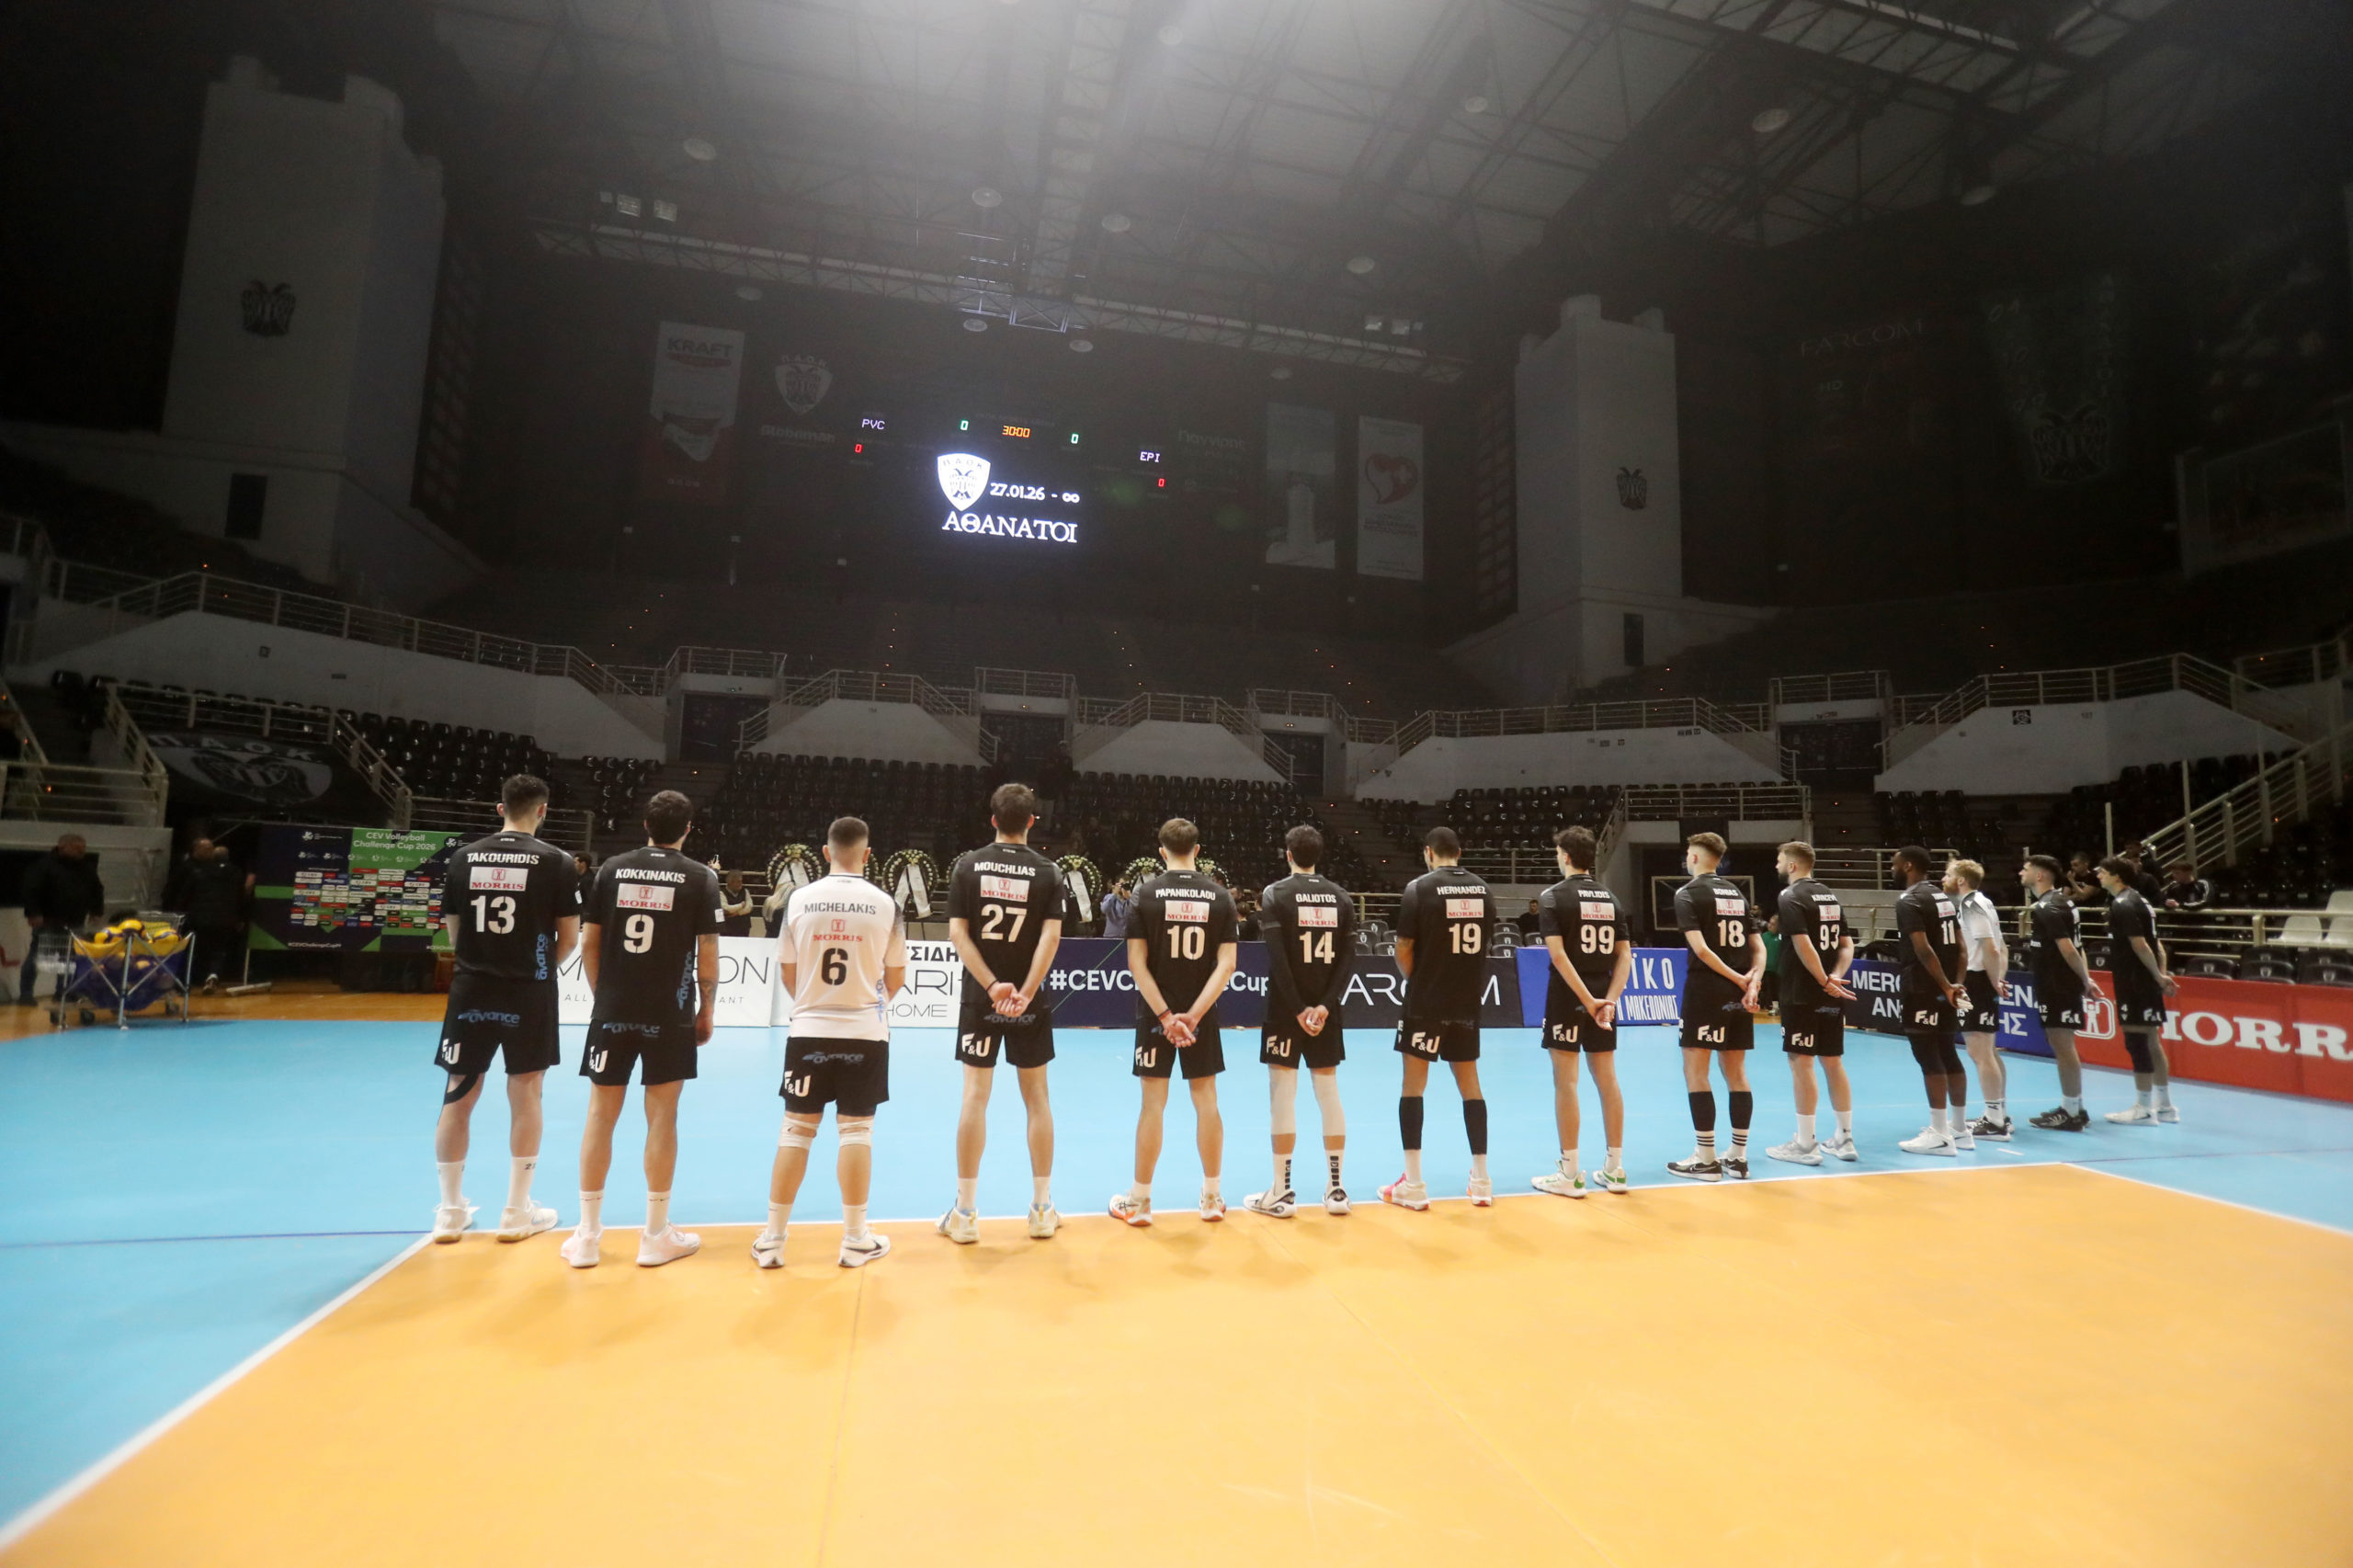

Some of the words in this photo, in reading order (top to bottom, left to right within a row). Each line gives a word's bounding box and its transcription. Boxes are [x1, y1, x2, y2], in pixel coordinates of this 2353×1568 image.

[667, 337, 733, 358] KRAFT
[861, 418, 885, 430] PVC
[960, 420, 969, 431] 0
[1071, 433, 1079, 444] 0
[855, 444, 862, 453] 0
[1140, 451, 1160, 463] EPI
[1158, 478, 1165, 488] 0
[990, 483, 1045, 501] 27.01.26
[942, 511, 1078, 543] ΑΘΑΝΑΤΟΙ
[353, 840, 395, 849] Challenge
[397, 842, 414, 850] Cup
[385, 832, 426, 842] Volleyball
[467, 853, 540, 865] TAKOURIDIS
[616, 868, 686, 884] KOKKINAKIS
[974, 862, 1036, 877] MOUCHLIAS
[472, 881, 525, 891] MORRIS
[1436, 885, 1486, 895] HERNANDEZ
[982, 890, 1026, 902] MORRIS
[1155, 888, 1216, 901] PAPANIKOLAOU
[1295, 893, 1336, 903] GALIOTOS
[619, 899, 671, 911] MORRIS
[804, 903, 876, 915] MICHELAKIS
[470, 895, 517, 935] 13
[981, 903, 1028, 942] 27
[1166, 913, 1208, 922] MORRIS
[623, 914, 655, 954] 9
[813, 934, 863, 942] MORRIS
[1449, 923, 1482, 954] 19
[1581, 925, 1615, 955] 99
[1717, 919, 1745, 948] 18
[1820, 924, 1840, 951] 93
[1941, 920, 1956, 945] 11
[1166, 926, 1206, 960] 10
[1299, 931, 1336, 964] 14
[906, 946, 959, 962] ΣΙΔΗ
[821, 948, 849, 986] 6
[564, 994, 587, 1002] ALL
[887, 1003, 948, 1017] HOME
[2039, 1005, 2048, 1013] 12
[1915, 1010, 1938, 1027] F&U
[1412, 1031, 1440, 1053] F&U
[1552, 1024, 1578, 1044] F&U
[1697, 1025, 1725, 1044] F&U
[1791, 1031, 1814, 1048] F&U
[961, 1033, 992, 1058] F&U
[1266, 1035, 1291, 1057] F&U
[784, 1070, 812, 1097] F&U
